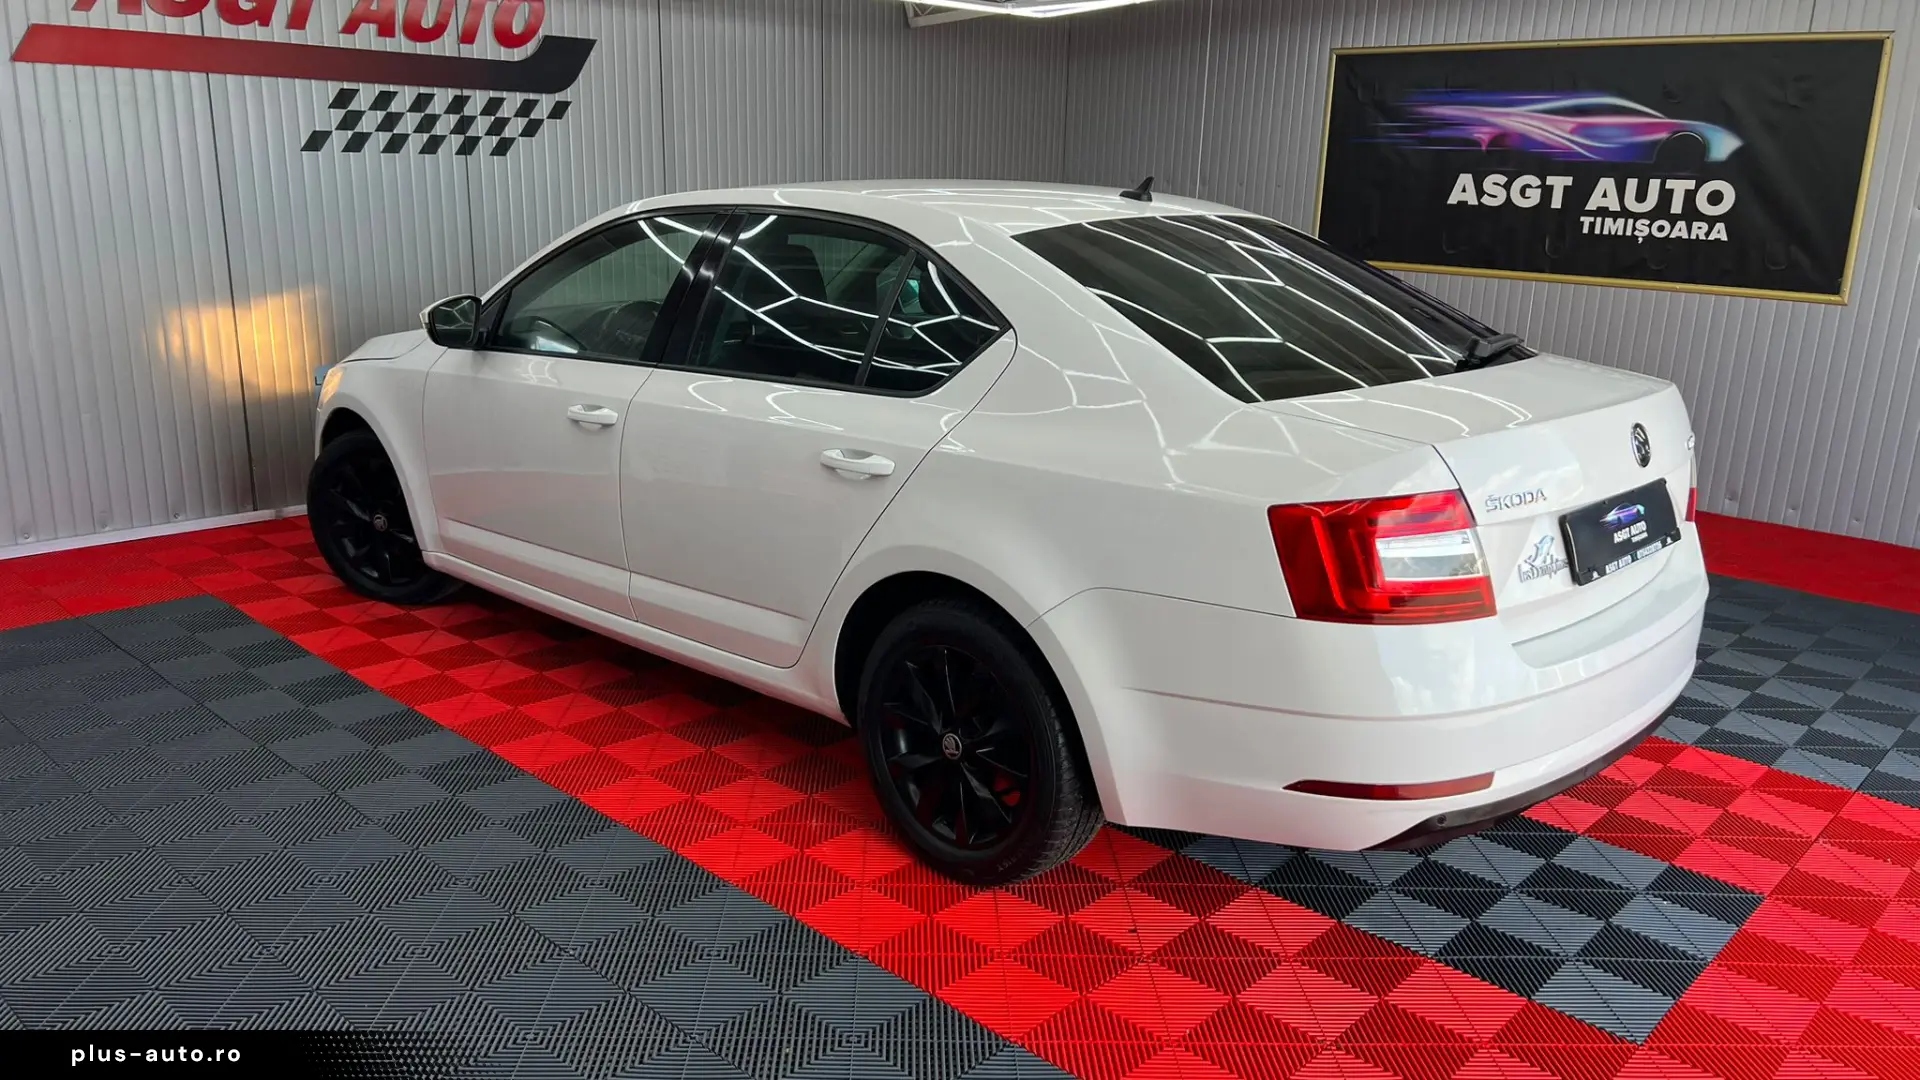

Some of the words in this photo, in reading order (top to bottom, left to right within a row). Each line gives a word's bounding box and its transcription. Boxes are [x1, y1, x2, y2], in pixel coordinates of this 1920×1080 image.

[1446, 172, 1574, 209] ASGT
[1584, 177, 1736, 217] AUTO
[1579, 216, 1729, 244] TIMIȘOARA
[1485, 488, 1547, 513] ŠKODA
